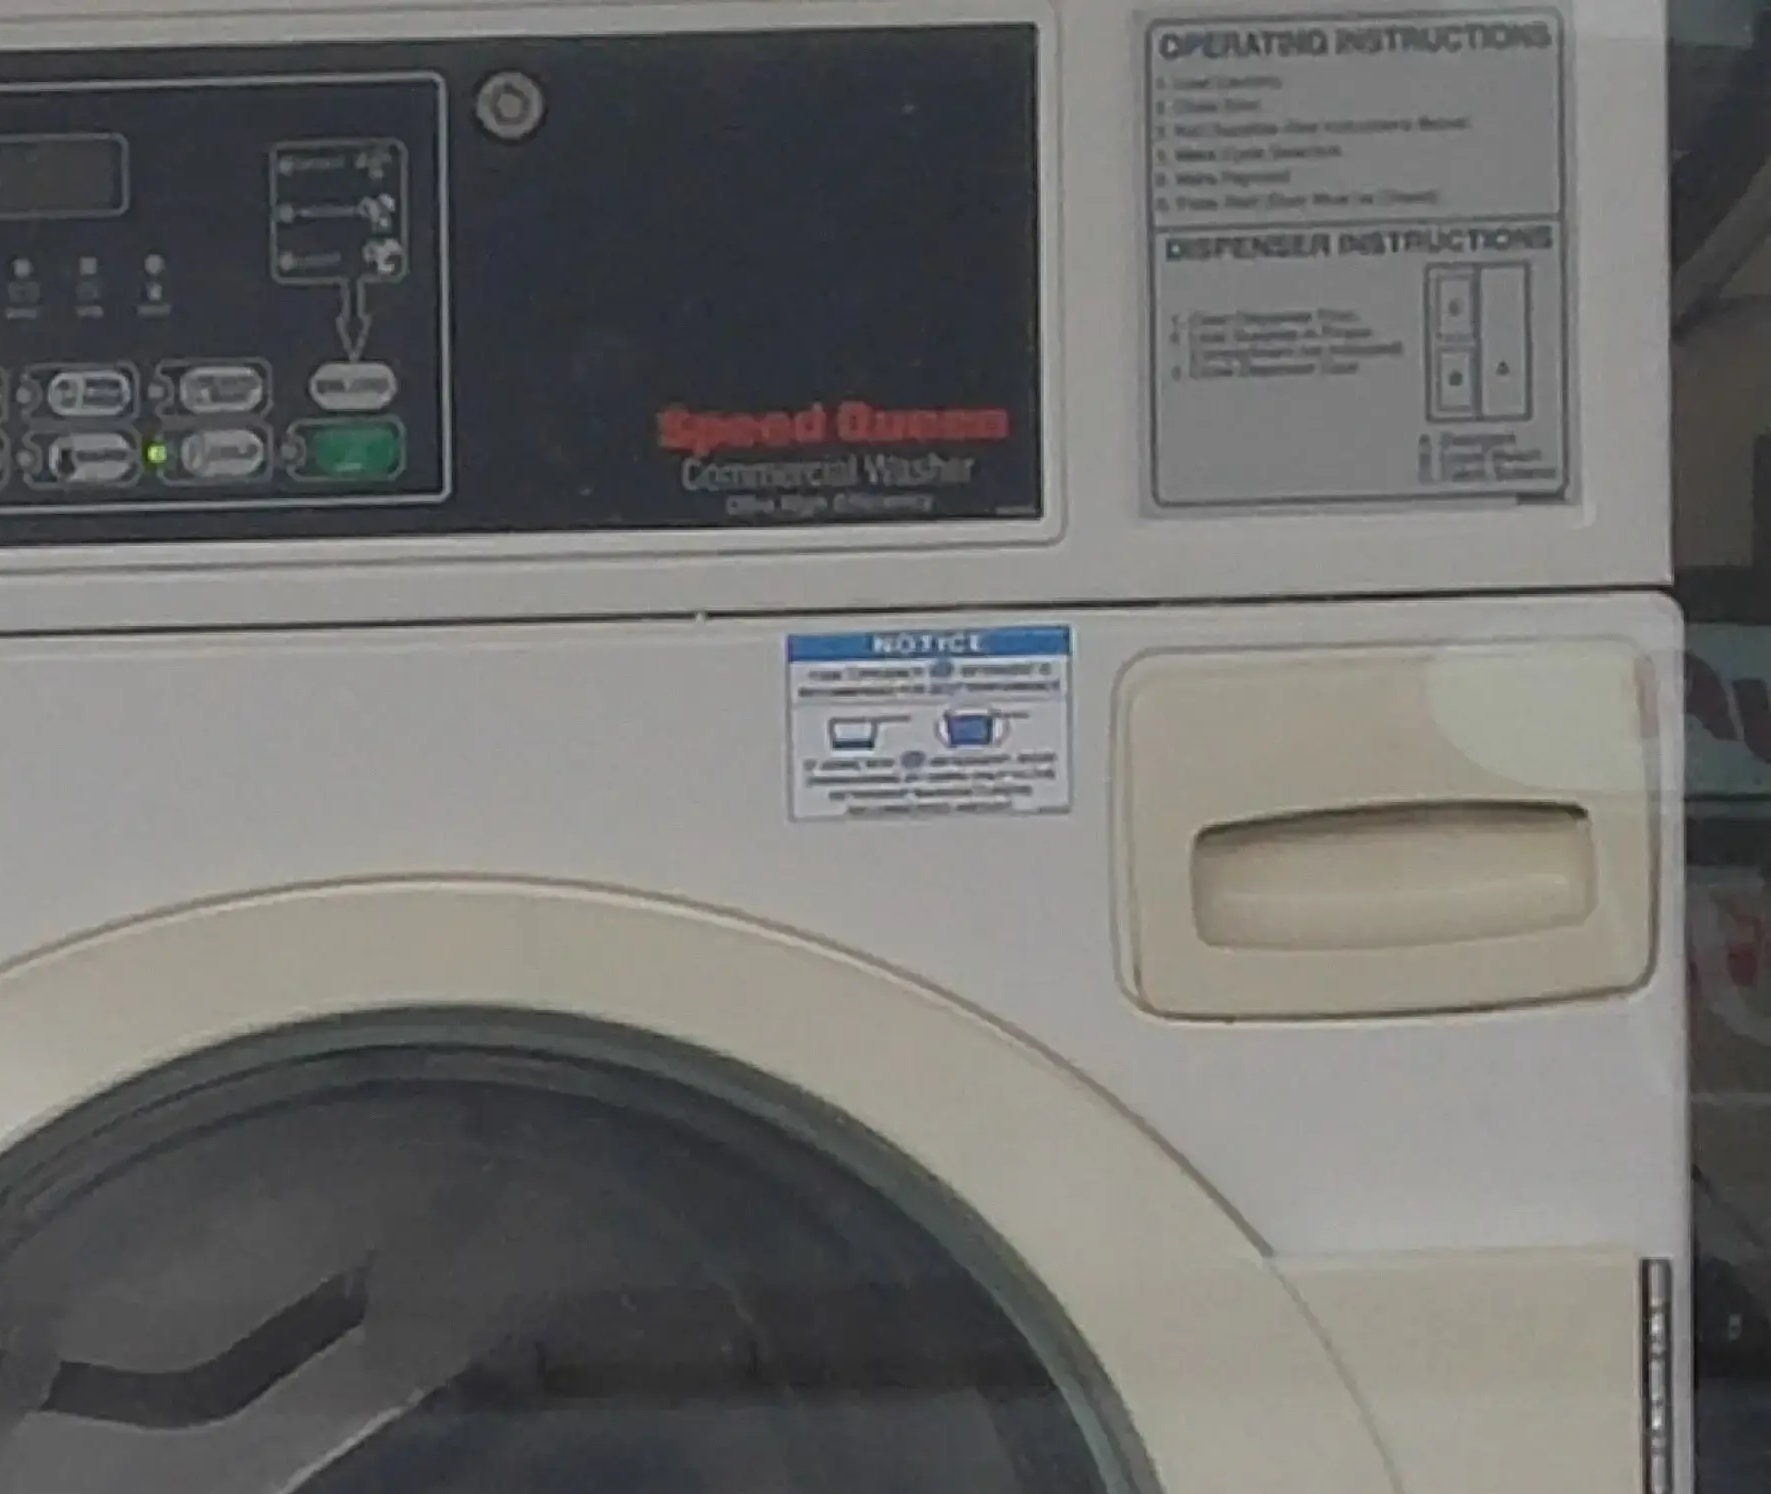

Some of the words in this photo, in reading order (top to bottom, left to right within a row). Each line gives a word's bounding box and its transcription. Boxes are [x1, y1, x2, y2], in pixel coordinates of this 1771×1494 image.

[1159, 30, 1328, 60] OPERATING
[1335, 22, 1551, 54] INSTRUCTIONS
[1166, 234, 1331, 261] DISPENSER
[1339, 226, 1554, 255] INSTRUCTIONS
[659, 403, 827, 455] Speed
[837, 400, 1009, 443] Queen
[681, 454, 856, 490] Commercial
[864, 452, 975, 486] Washer
[872, 633, 983, 654] NOTICE
